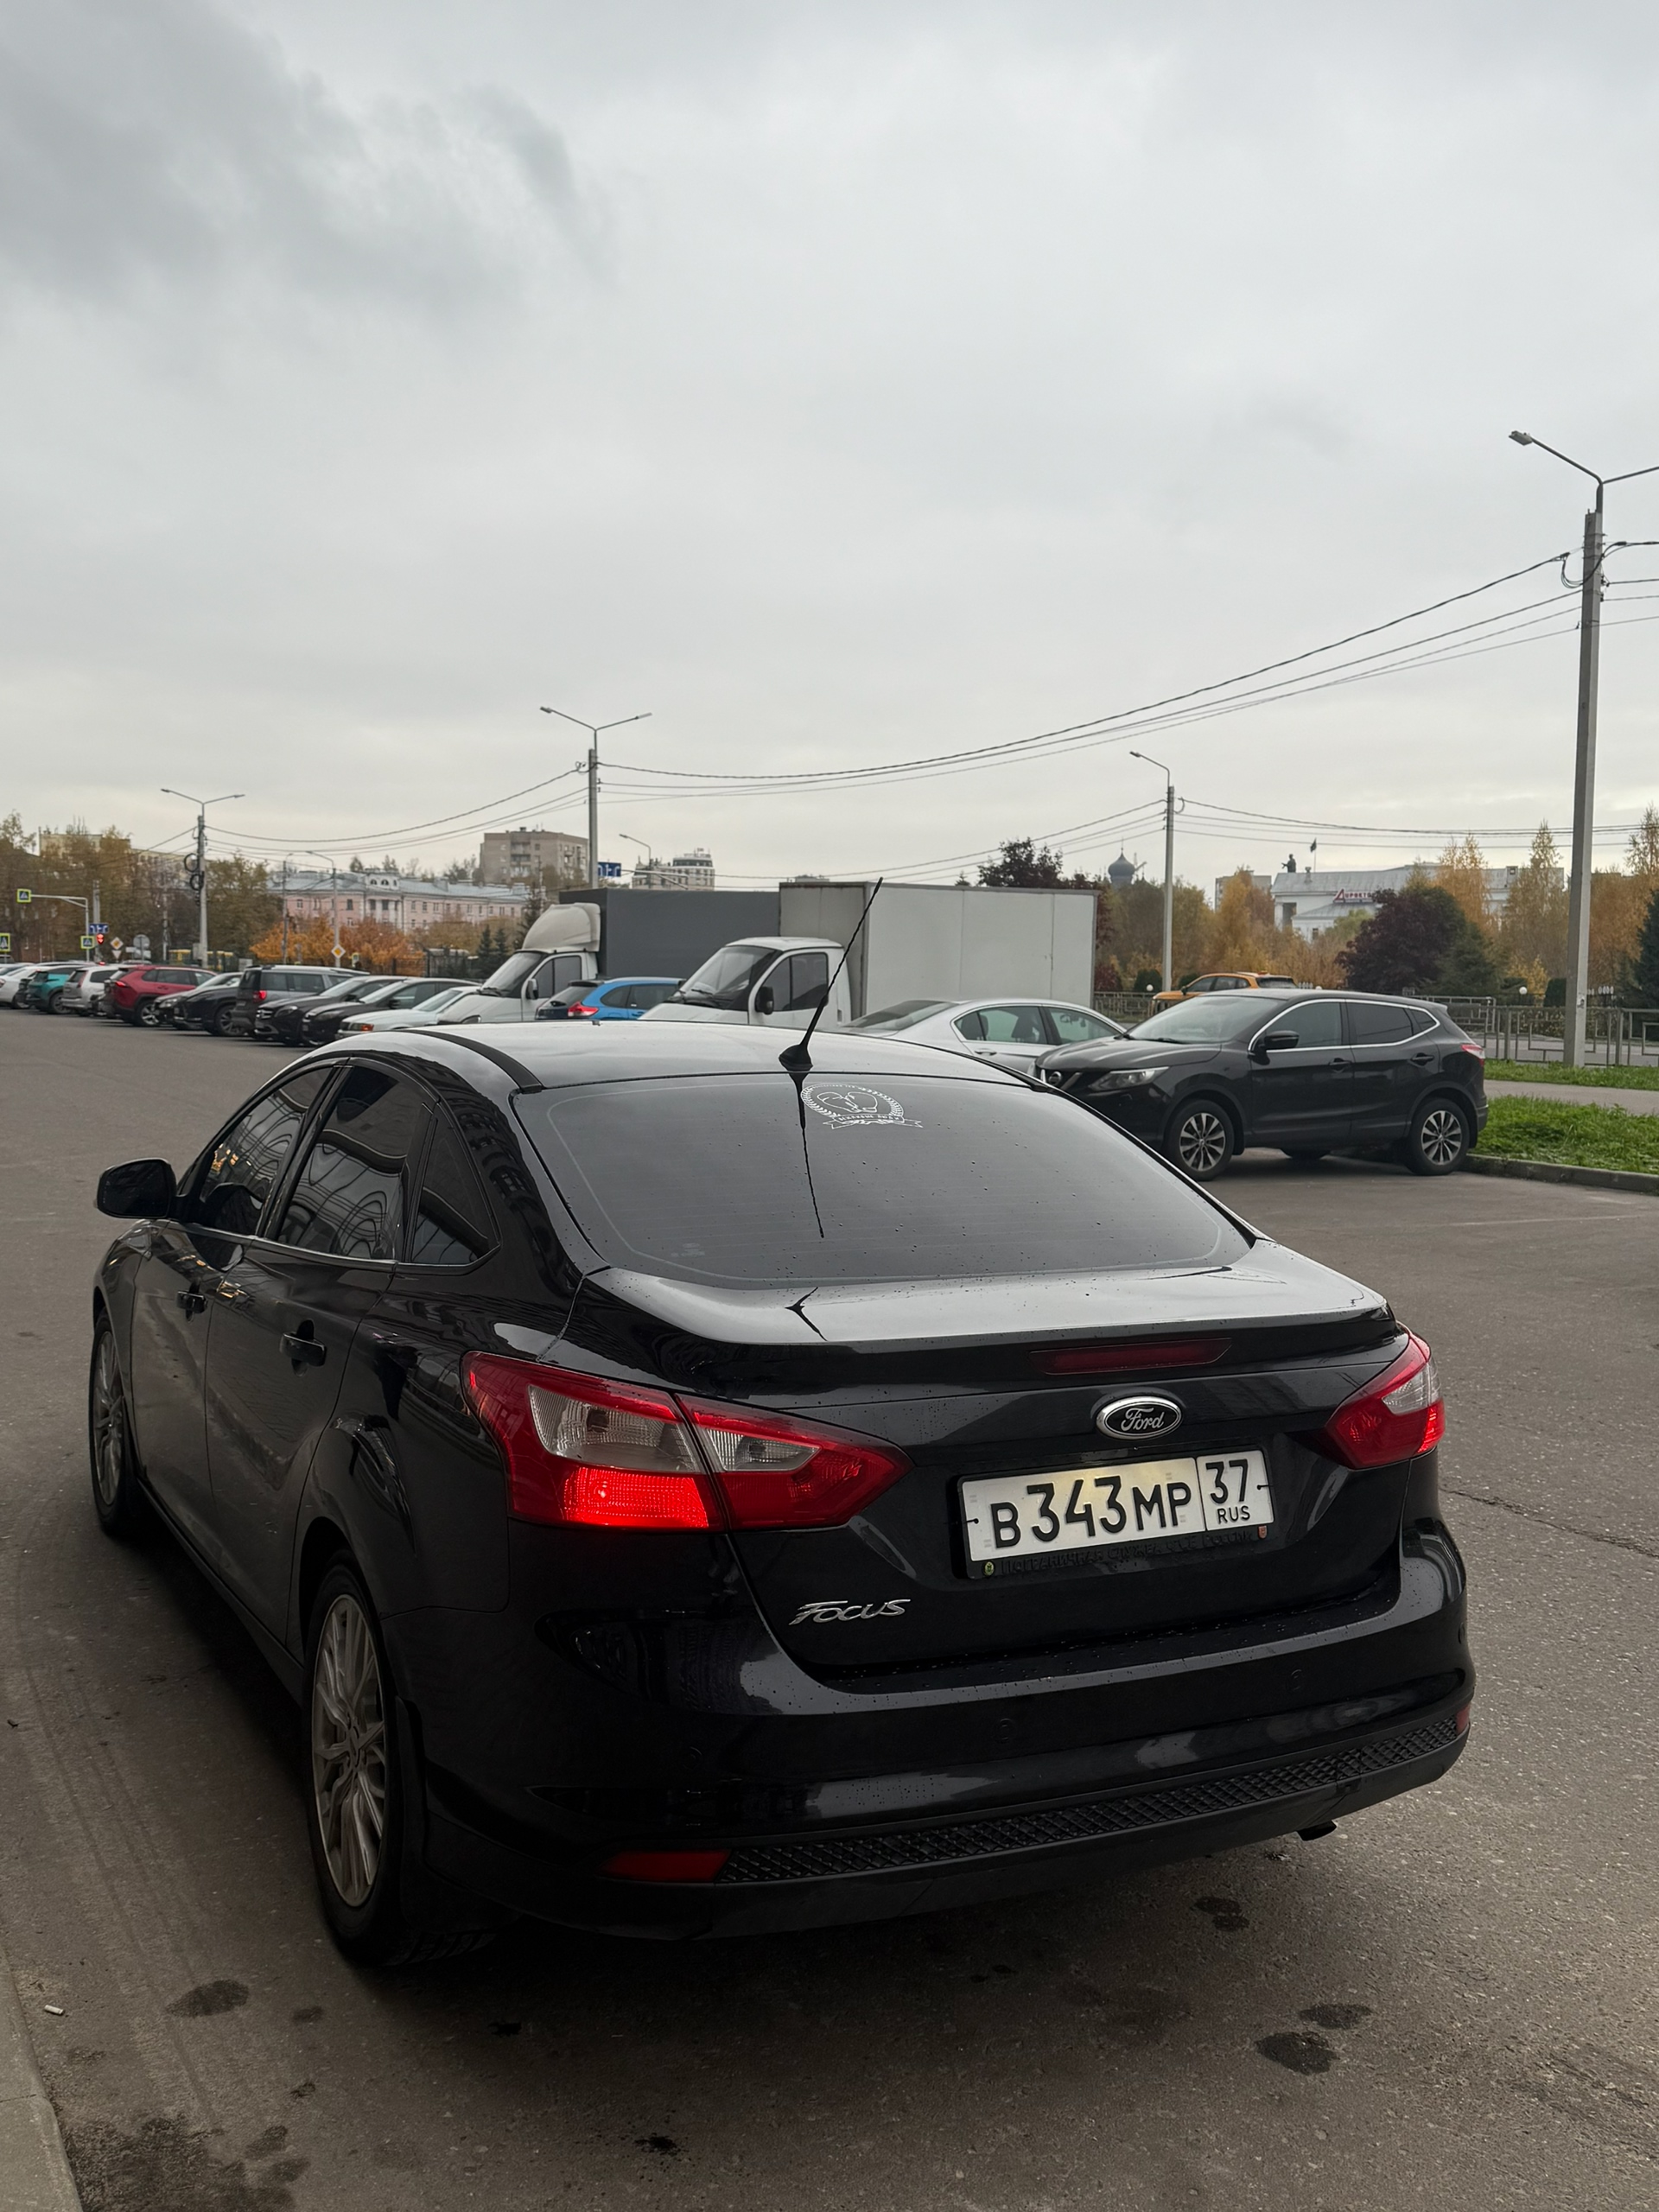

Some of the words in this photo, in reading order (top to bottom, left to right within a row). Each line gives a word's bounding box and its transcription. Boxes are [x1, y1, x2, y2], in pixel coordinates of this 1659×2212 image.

[1121, 1407, 1166, 1433] Ford
[1205, 1459, 1249, 1505] 37
[1217, 1505, 1251, 1524] RUS
